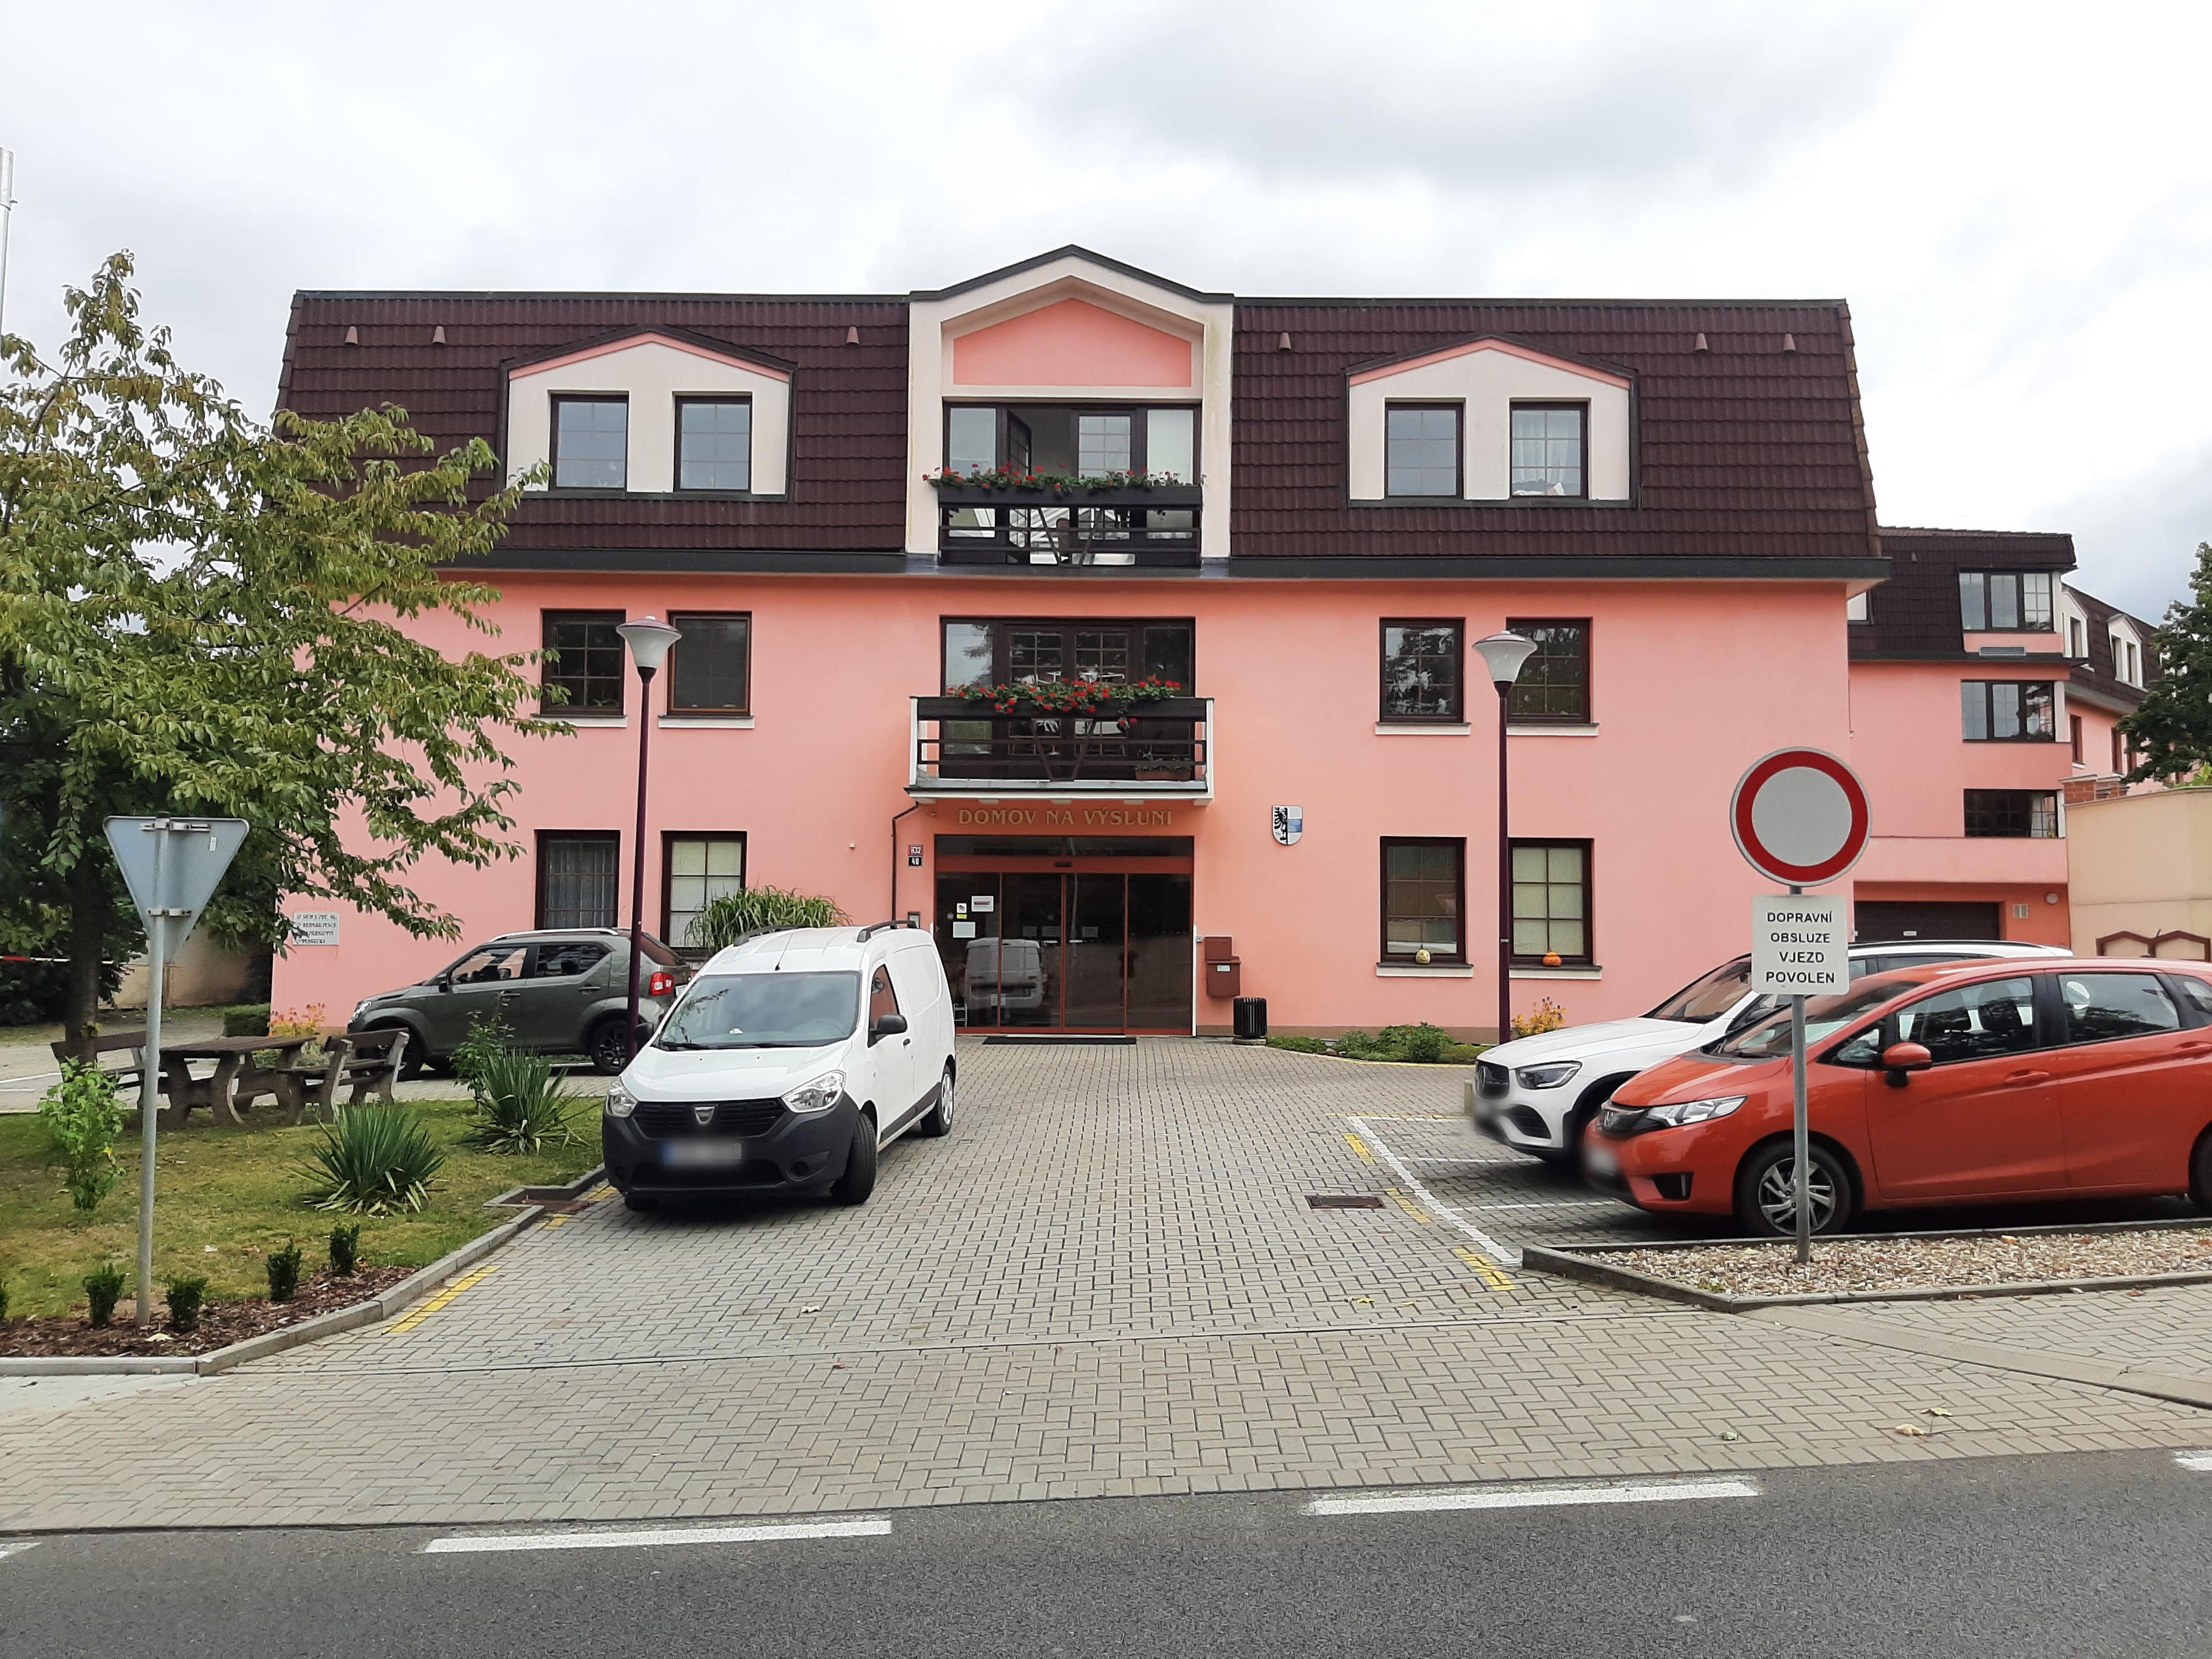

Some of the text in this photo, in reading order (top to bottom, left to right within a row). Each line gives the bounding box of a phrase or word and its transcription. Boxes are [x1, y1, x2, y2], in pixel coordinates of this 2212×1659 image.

[958, 806, 1172, 825] DOMOV NA VÝSLUNÍ
[1767, 910, 1832, 923] DOPRAVNÍ
[1771, 932, 1830, 943] OBSLUZE
[1779, 951, 1824, 963] VJEZD
[1766, 971, 1834, 984] POVOLEN
